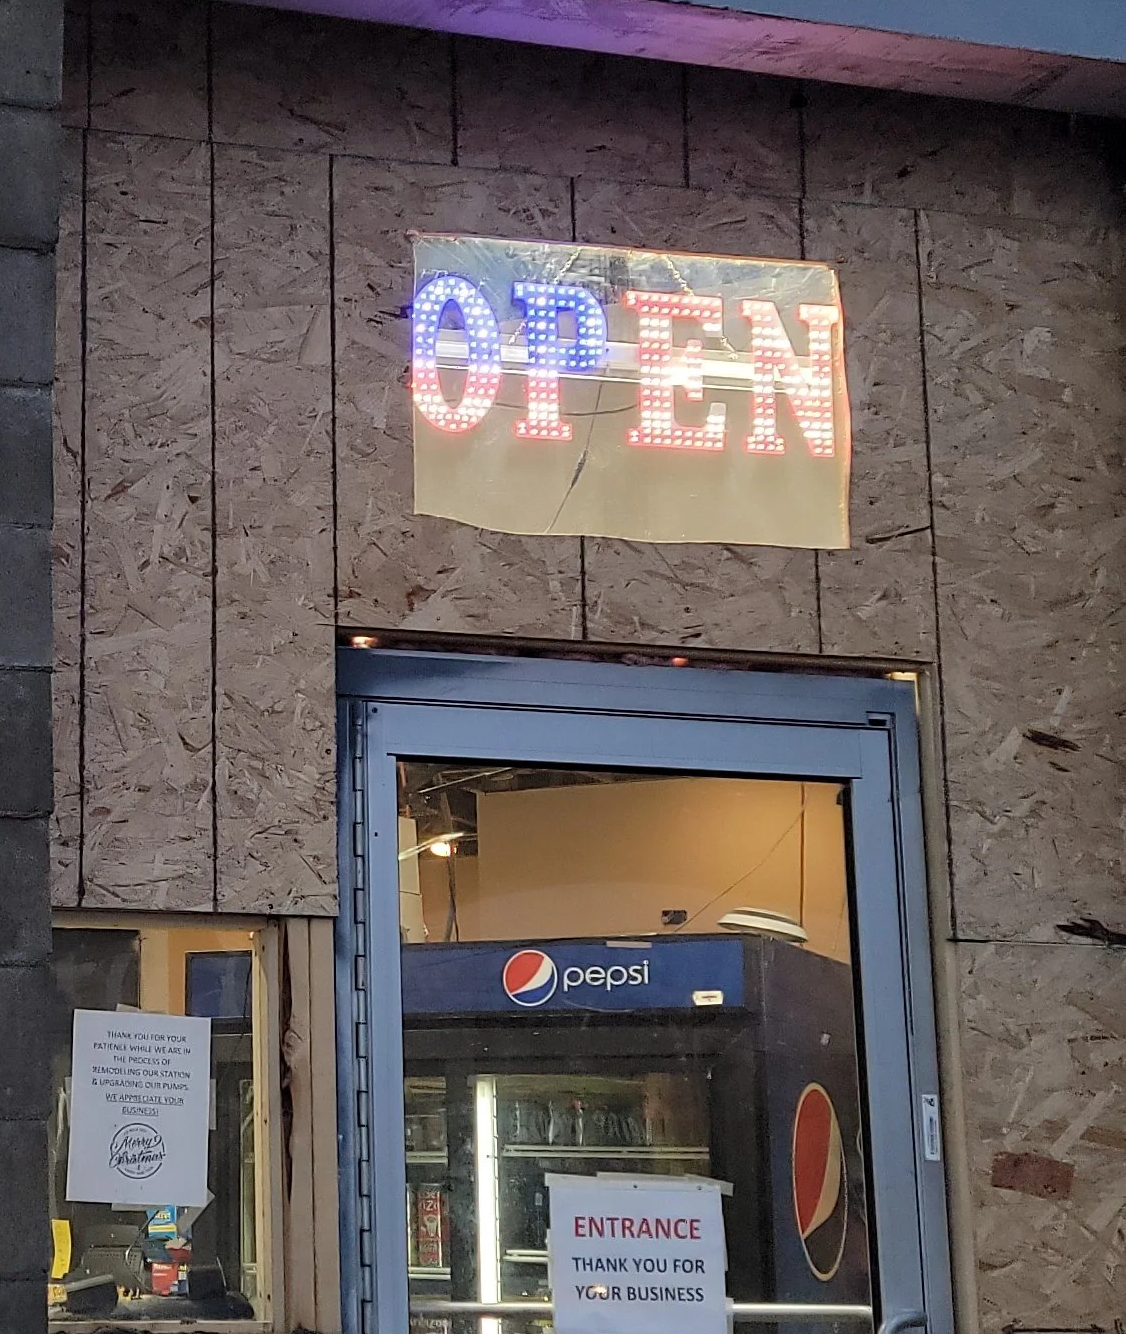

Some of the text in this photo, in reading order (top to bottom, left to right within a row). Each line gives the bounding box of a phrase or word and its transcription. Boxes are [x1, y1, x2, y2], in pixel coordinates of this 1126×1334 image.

[412, 274, 838, 457] OPEN
[563, 959, 650, 993] pepsi
[107, 1031, 186, 1043] THANK YOU FOR YOUR
[154, 1046, 166, 1054] WE
[168, 1047, 182, 1055] ARE
[114, 1055, 126, 1063] THE
[142, 1069, 159, 1078] OUR
[160, 1070, 191, 1079] STATION
[145, 1081, 161, 1090] OUR
[164, 1096, 184, 1105] YOUR
[573, 1215, 702, 1242] ENTRANCE
[572, 1256, 706, 1275] THANK YOU FOR
[574, 1282, 705, 1304] YOUR BUSINESS
